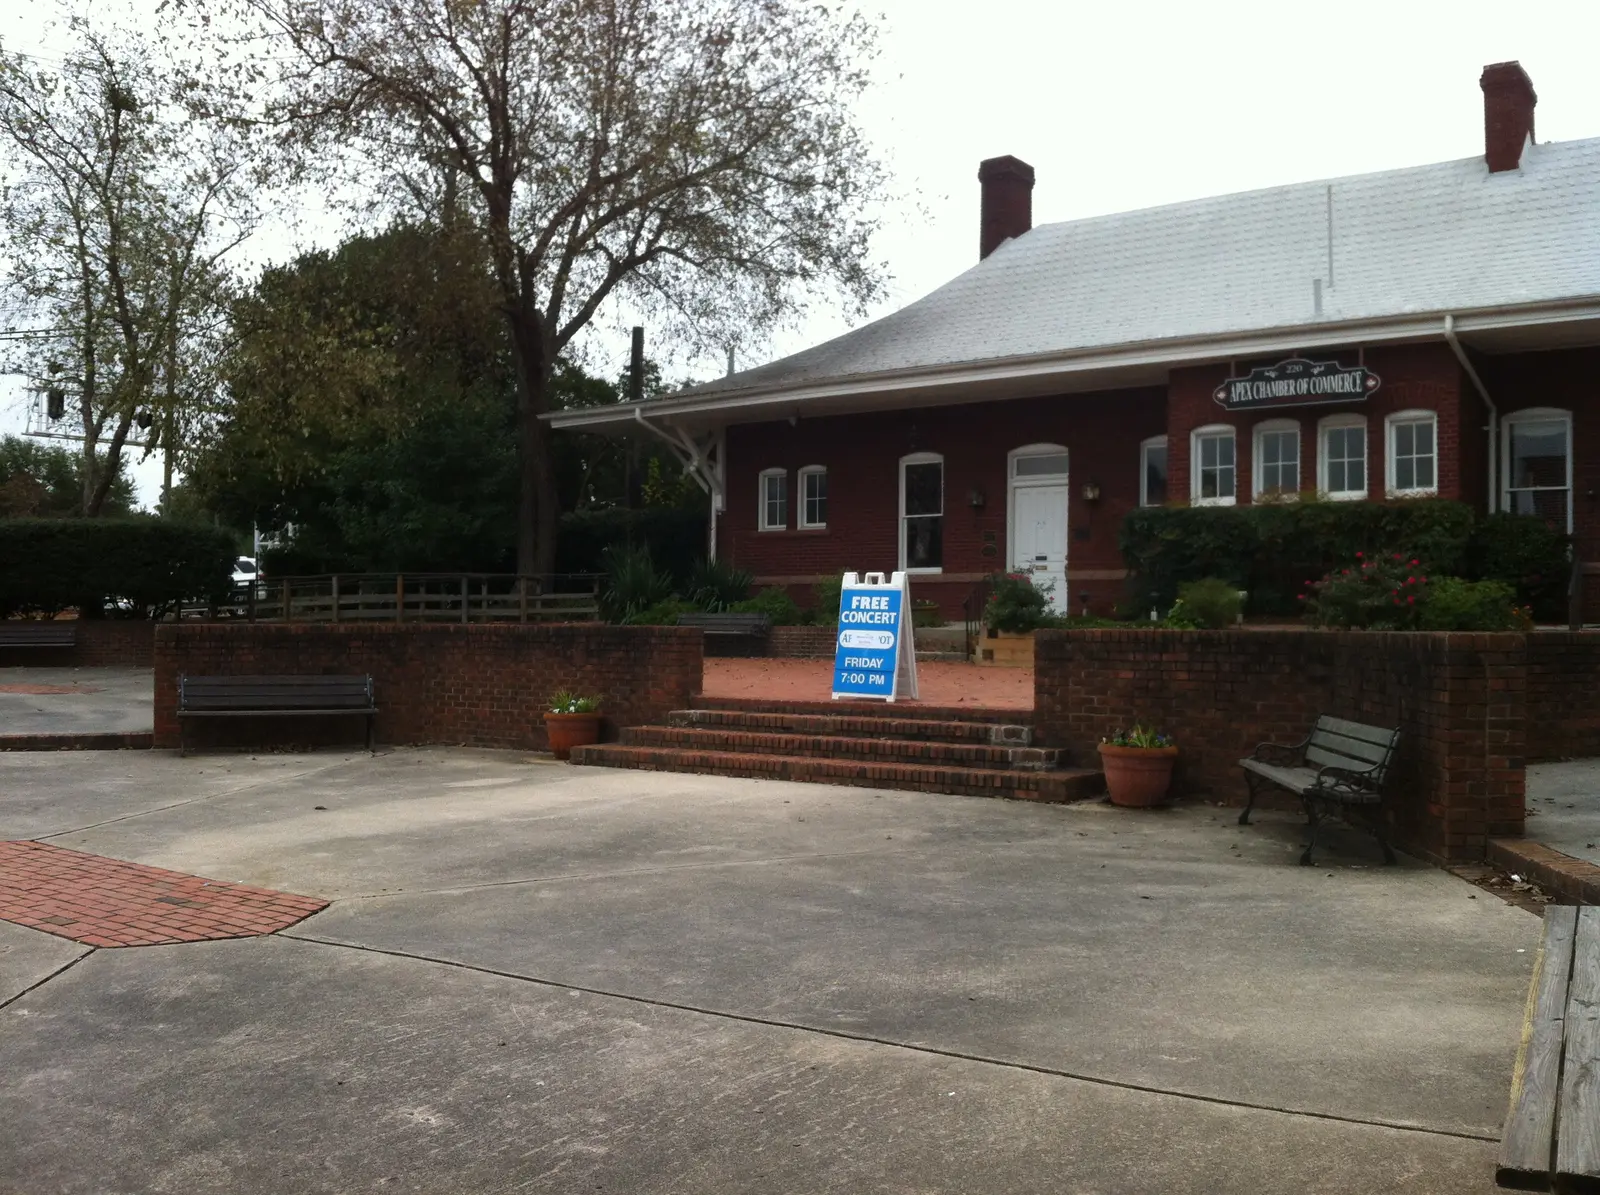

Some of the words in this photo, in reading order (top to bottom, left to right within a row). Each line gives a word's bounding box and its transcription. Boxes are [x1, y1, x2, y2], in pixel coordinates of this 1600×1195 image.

[1286, 364, 1303, 374] 220
[1230, 382, 1253, 402] APEX
[1253, 380, 1296, 400] CHAMBER
[1296, 378, 1309, 395] OF
[1310, 371, 1363, 395] COMMERCE
[851, 595, 890, 610] FREE
[841, 611, 897, 624] CONCERT
[844, 657, 884, 668] FRIDAY
[841, 672, 865, 684] 7:00
[868, 674, 885, 685] PM
